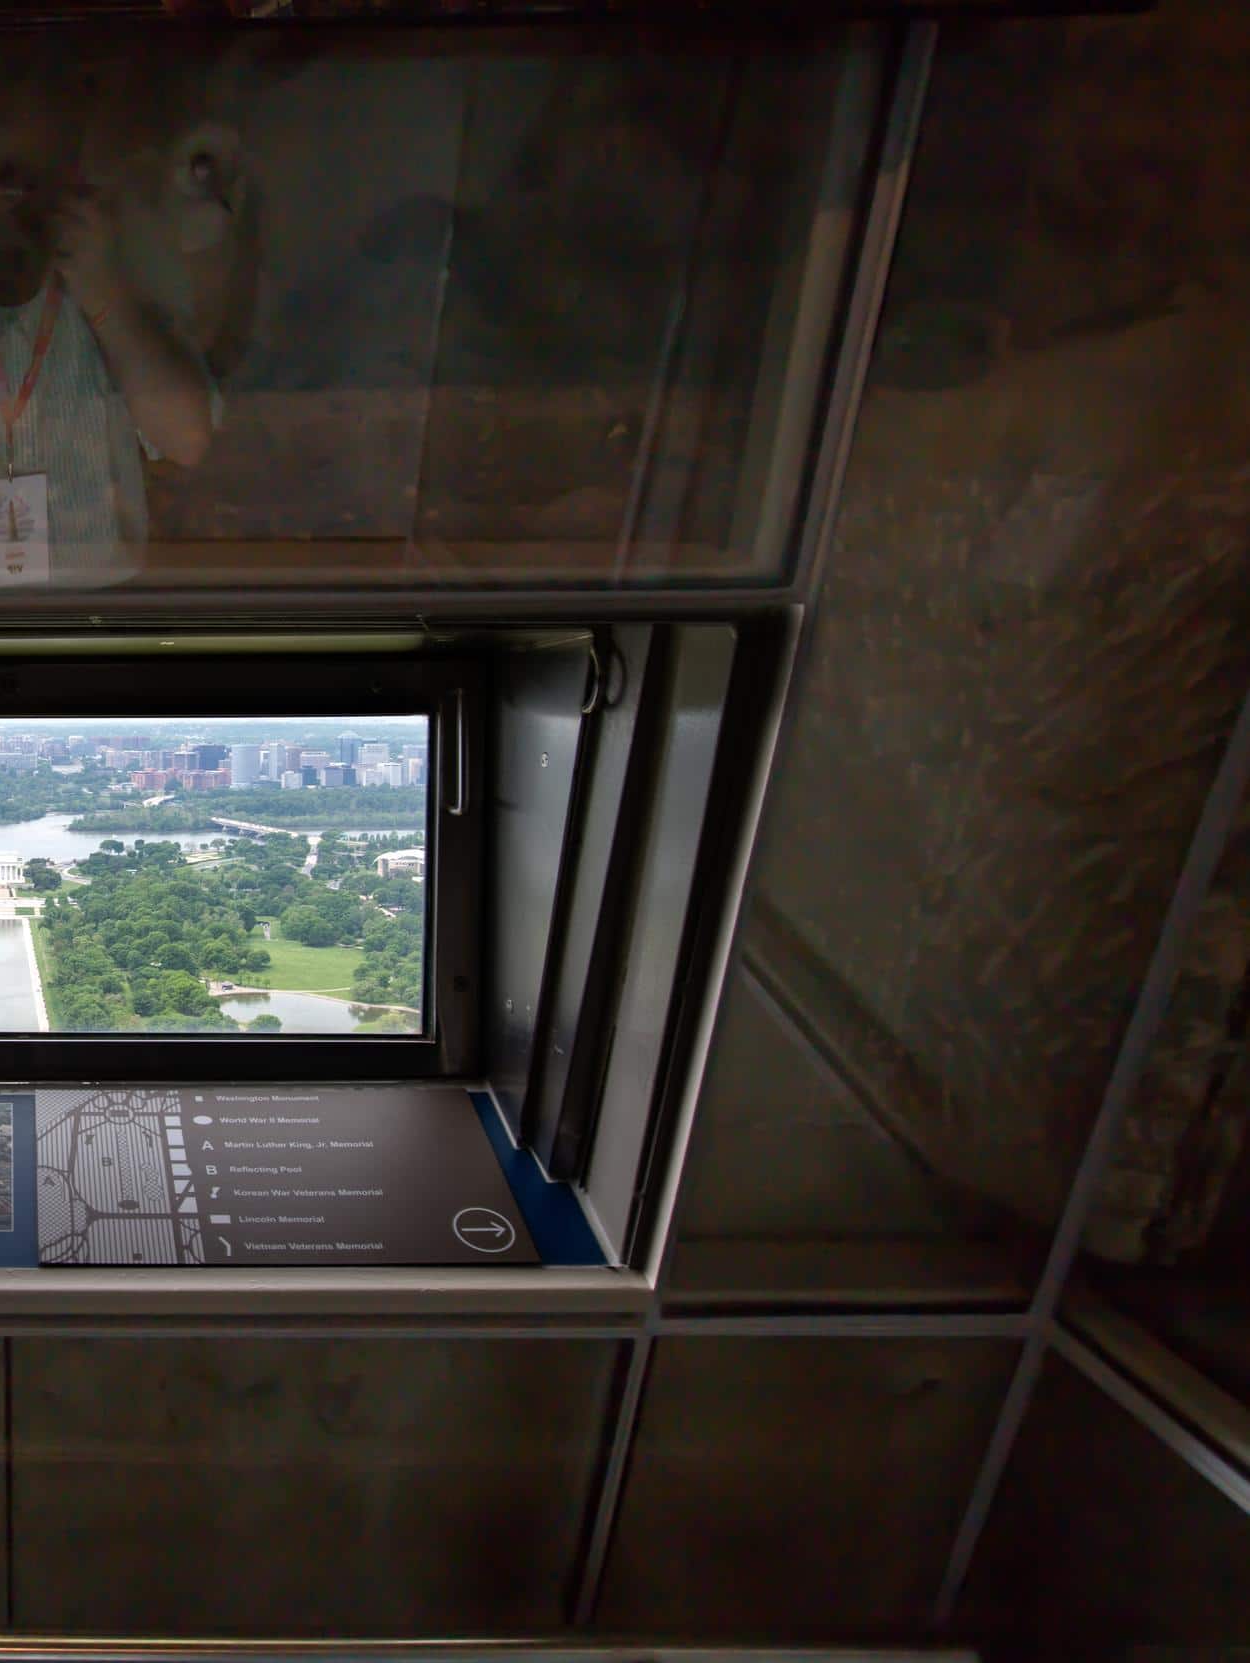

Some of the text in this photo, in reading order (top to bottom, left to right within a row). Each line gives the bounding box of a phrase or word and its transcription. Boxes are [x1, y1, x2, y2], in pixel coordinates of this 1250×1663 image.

[215, 1095, 269, 1103] Washington
[202, 1140, 214, 1150] A
[256, 1141, 287, 1149] Luther
[289, 1141, 313, 1150] King,
[330, 1140, 374, 1148] Memorial
[101, 1157, 113, 1167] B
[205, 1165, 218, 1175] B
[229, 1166, 278, 1175] Reflecting
[233, 1189, 383, 1197] Korean War Veterans Memorial
[239, 1215, 325, 1224] Lincoln Memorial
[245, 1242, 383, 1251] Vietnam Veterans Memorial
